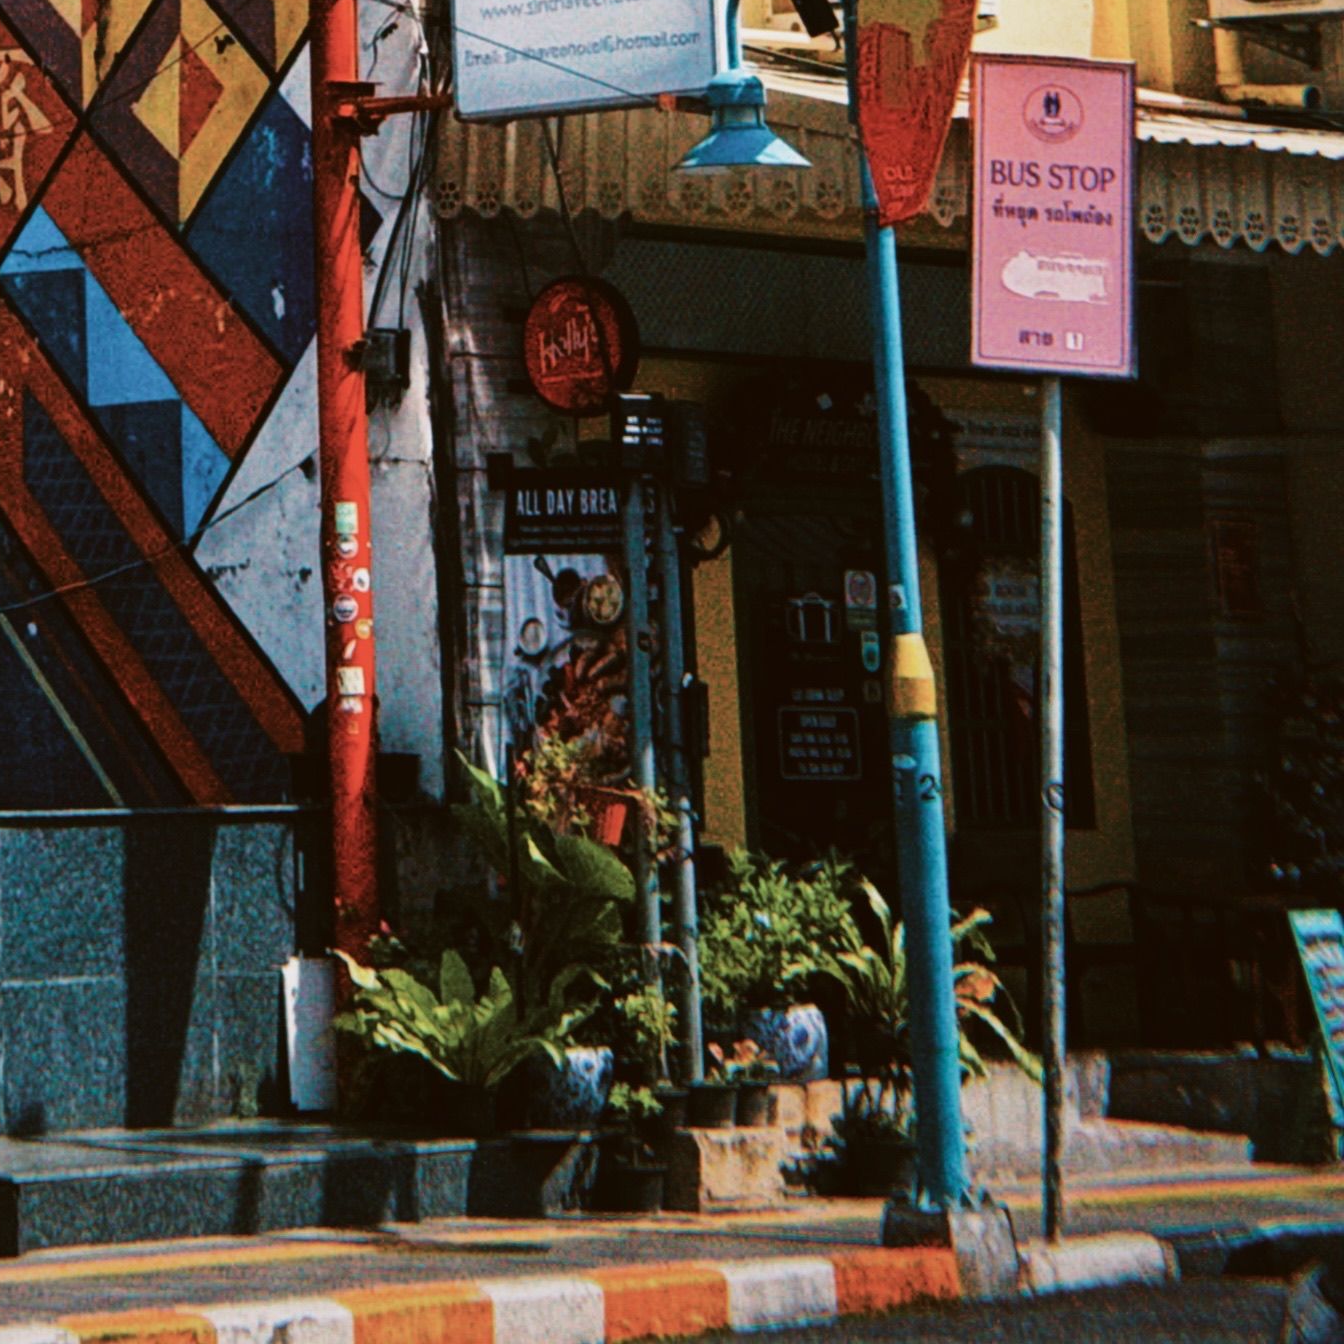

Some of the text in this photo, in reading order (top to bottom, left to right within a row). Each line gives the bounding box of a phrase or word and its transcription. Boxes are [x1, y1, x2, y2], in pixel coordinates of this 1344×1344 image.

[991, 159, 1116, 192] BUS STOP
[516, 488, 541, 516] ALL
[546, 488, 575, 516] DAY
